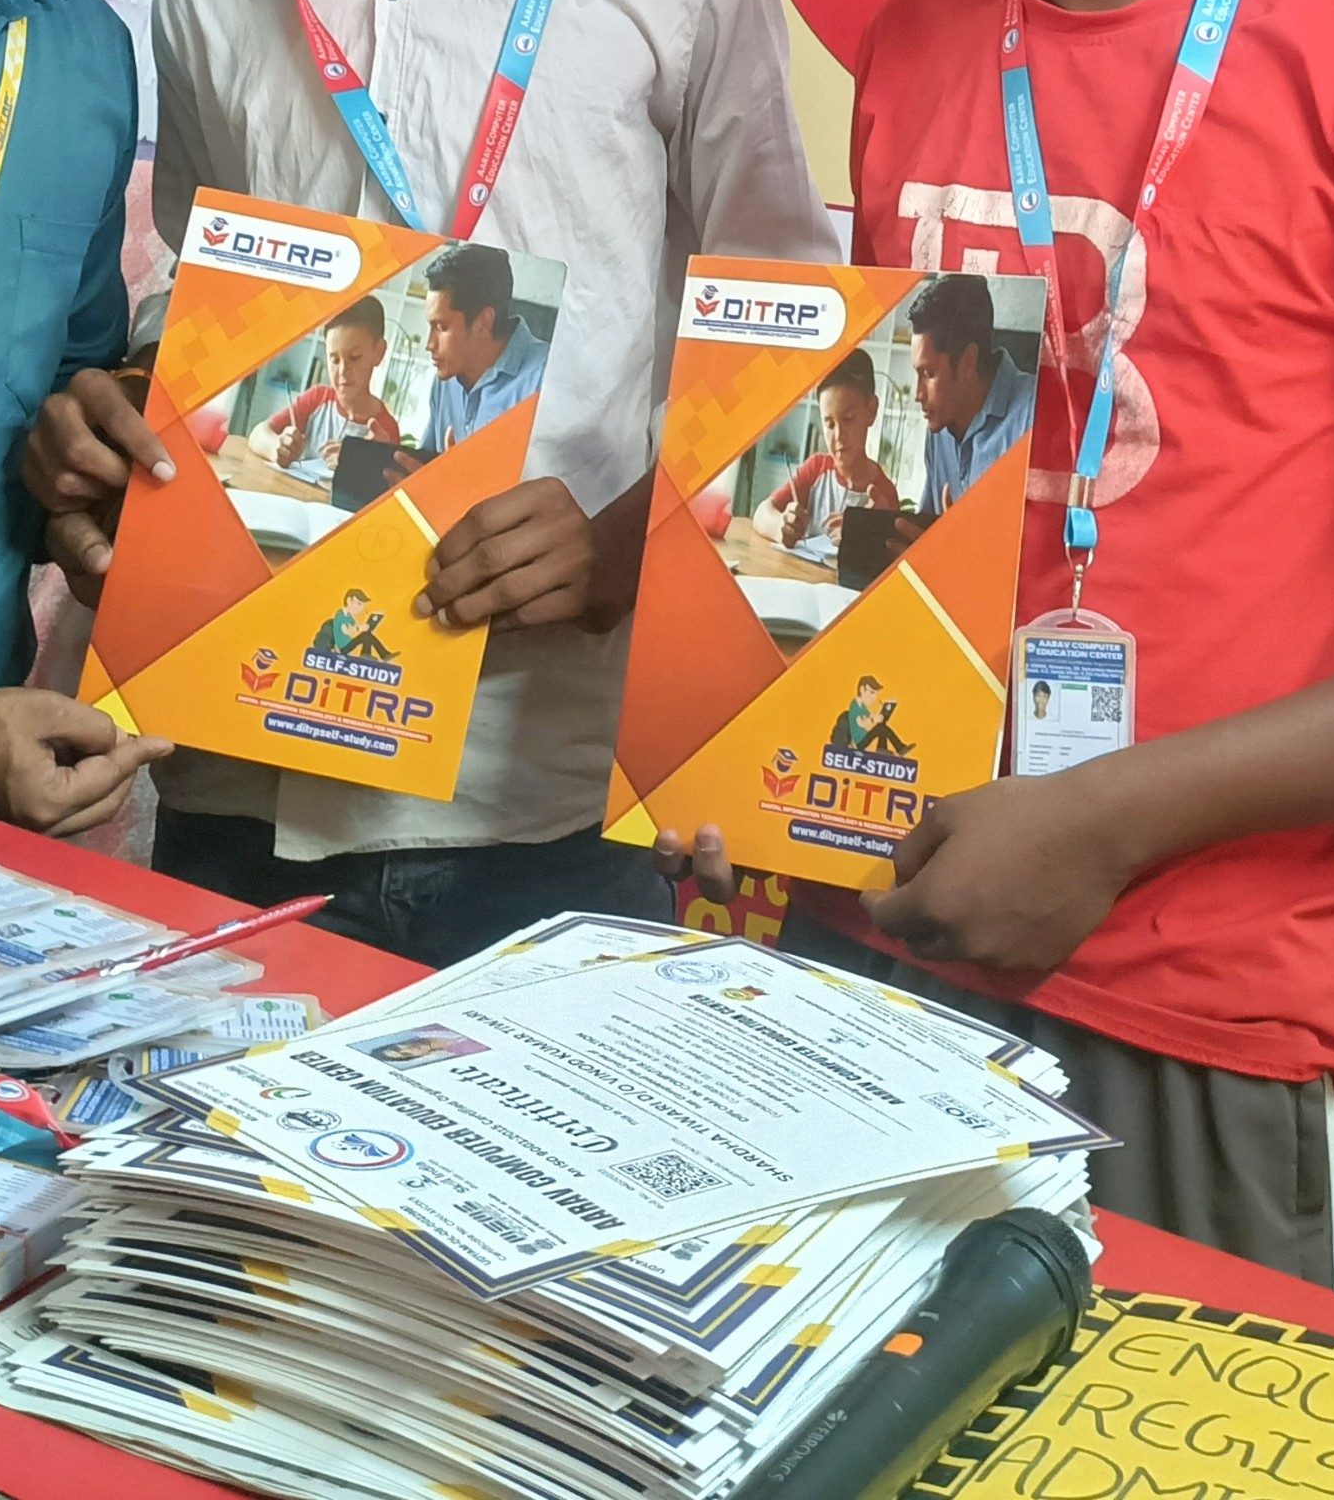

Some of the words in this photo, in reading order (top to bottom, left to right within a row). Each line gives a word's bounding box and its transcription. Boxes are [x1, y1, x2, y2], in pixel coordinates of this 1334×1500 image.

[520, 0, 536, 28] AARAV
[476, 148, 493, 178] AARAV
[486, 98, 507, 146] COMPUTER
[484, 136, 508, 184] EDUCATION
[500, 99, 518, 133] CENTER
[1150, 141, 1170, 177] AARAV
[1163, 89, 1188, 142] COMPUTER
[1156, 128, 1188, 186] EDUCATION
[1180, 91, 1202, 129] CENTER
[232, 232, 333, 268] DiTRP
[723, 298, 818, 326] DiTRP
[1035, 647, 1088, 659] EDUCATION
[1089, 651, 1123, 660] CENTER
[1038, 640, 1070, 648] AARAV
[1071, 642, 1121, 652] COMPUTER
[305, 654, 400, 685] SELF-STUDY
[284, 672, 434, 726] DiTRP
[268, 717, 395, 752] www.ditrpself-study.com
[824, 751, 916, 781] SELF-STUDY
[791, 823, 893, 855] www.ditrpself-study
[458, 1007, 518, 1034] TIWARI
[685, 992, 737, 1016] CENTER
[509, 1030, 574, 1061] KUMAR
[727, 1013, 799, 1047] EDUCATION
[286, 1049, 361, 1083] CENTER
[564, 1057, 624, 1085] VINOD
[788, 1045, 865, 1082] COMPUTER
[385, 1069, 453, 1102] Organization
[609, 1082, 658, 1103] D/O
[852, 1080, 908, 1105] AARAV
[345, 1077, 456, 1130] EDUCATION
[440, 1062, 627, 1155] Certificate
[443, 1100, 496, 1125] Certified
[645, 1100, 714, 1134] TIWARI
[437, 1127, 561, 1188] COMPUTER
[542, 1155, 571, 1168] ISO
[562, 1167, 587, 1178] An
[701, 1133, 800, 1182] SHARDHA
[536, 1186, 630, 1230] AARAV
